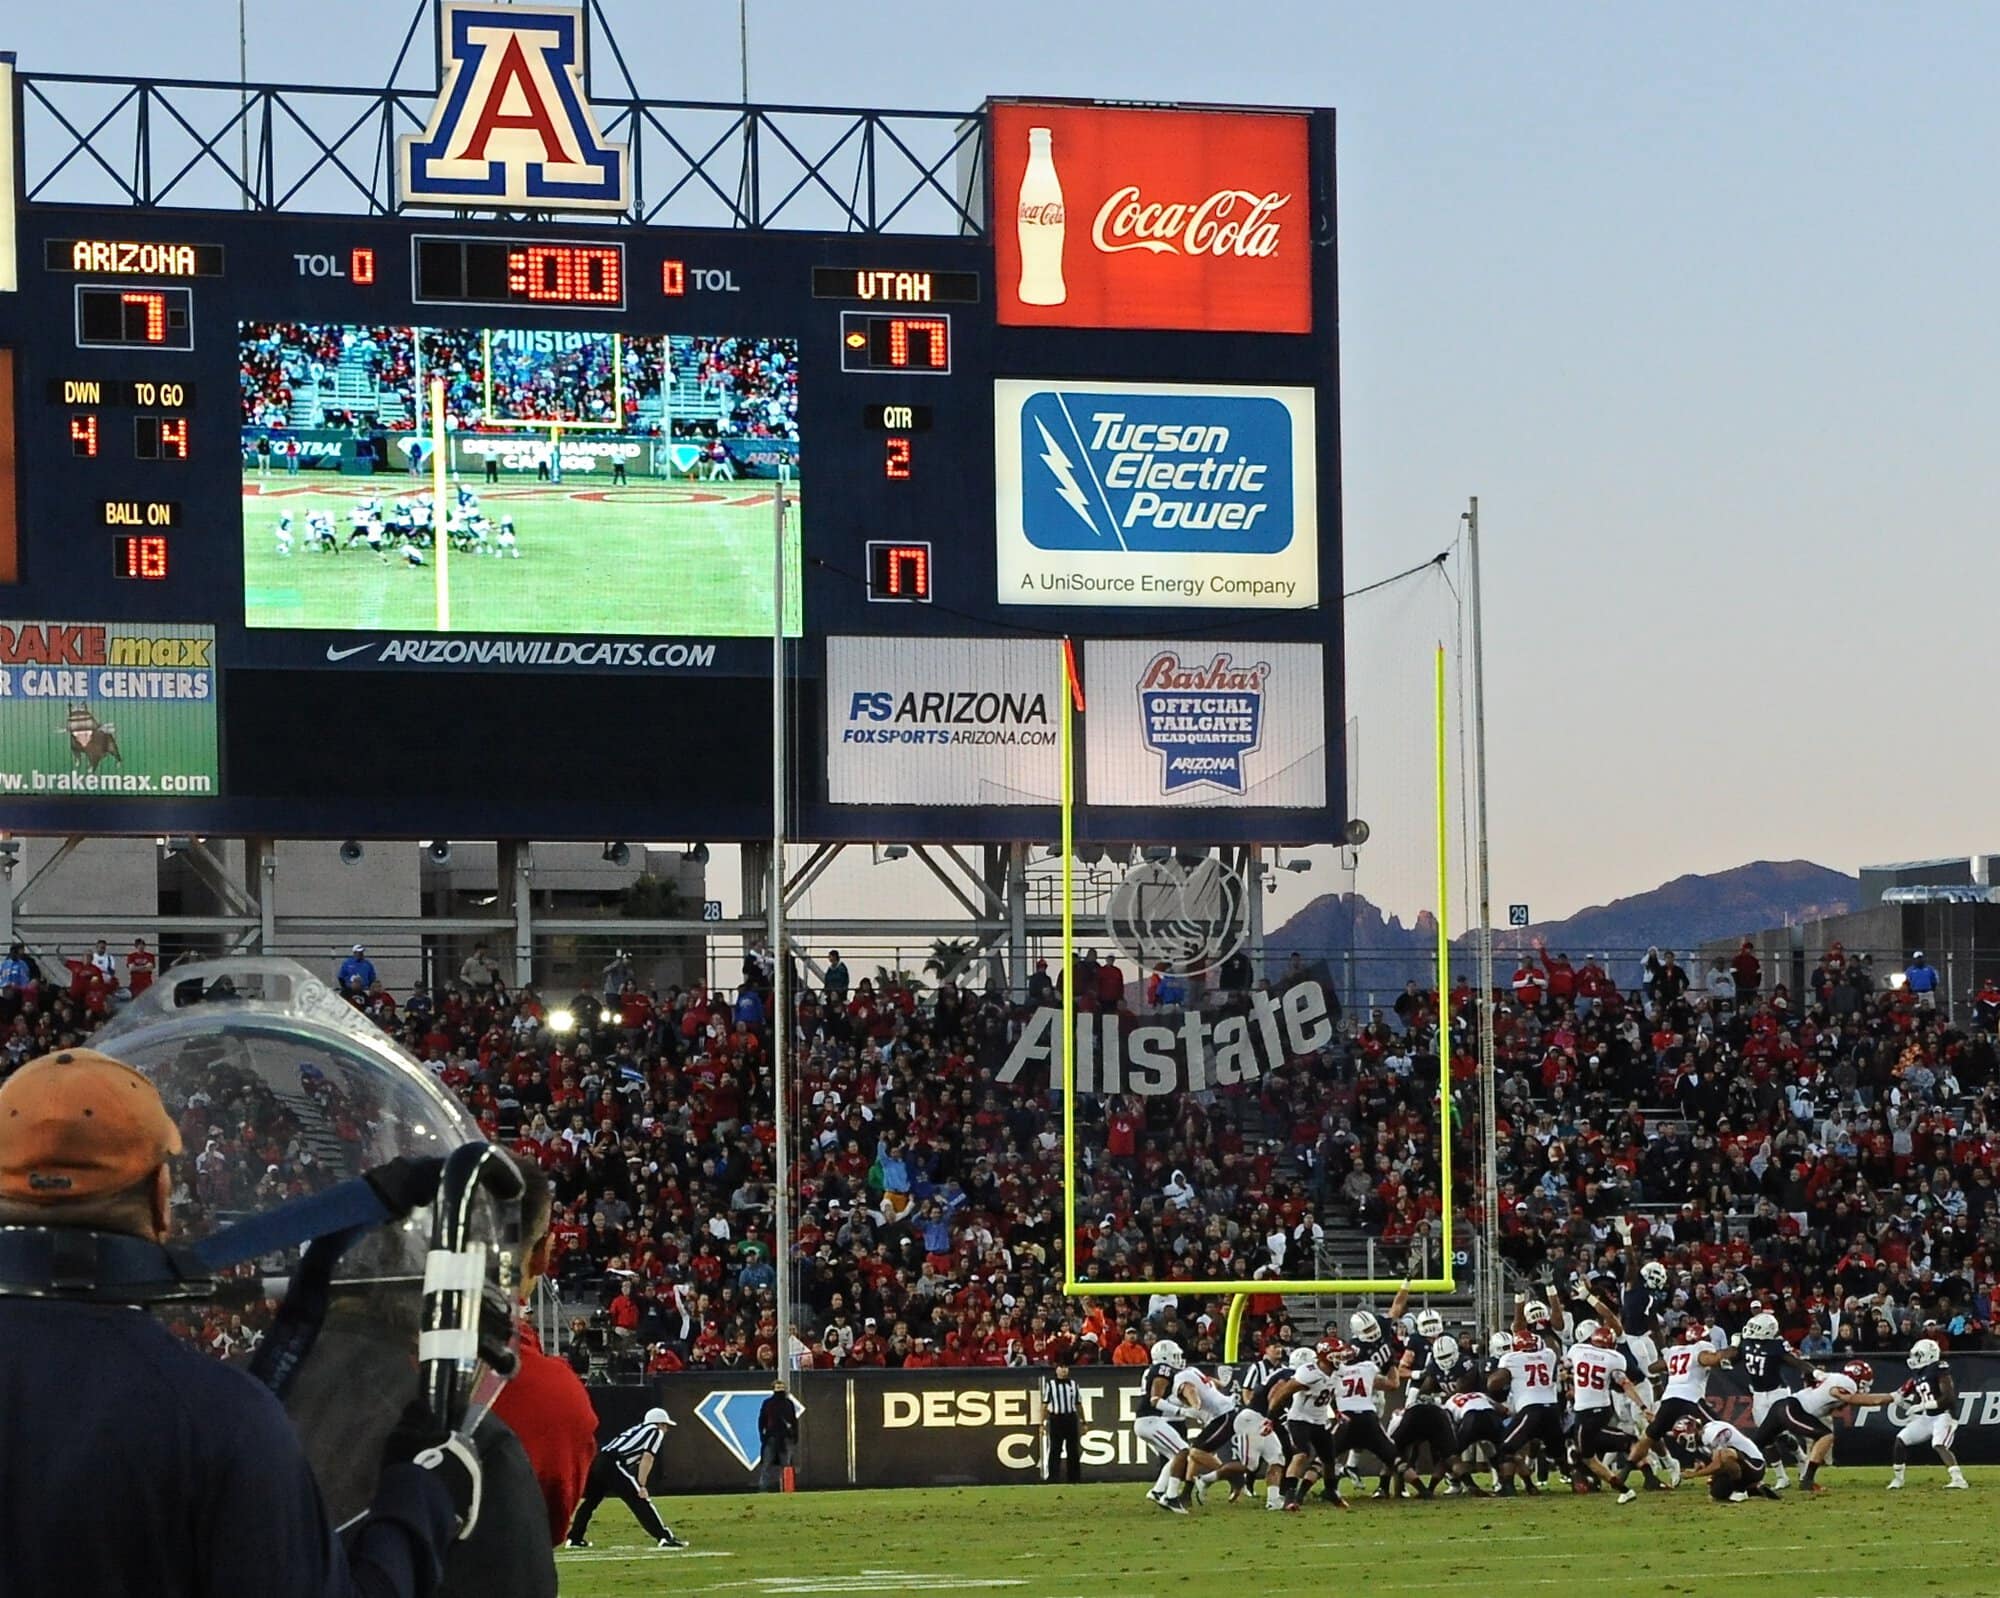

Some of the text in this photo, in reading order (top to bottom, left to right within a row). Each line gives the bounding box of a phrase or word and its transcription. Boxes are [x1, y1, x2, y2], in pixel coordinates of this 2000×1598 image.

[410, 10, 620, 201] A
[1092, 186, 1291, 258] Coca-Cola
[73, 241, 196, 275] ARIZONA
[294, 254, 345, 277] TOL
[352, 248, 374, 284] 0
[663, 260, 684, 296] 0
[692, 269, 740, 293] TOL
[857, 271, 931, 302] UTAH
[122, 292, 164, 341] 7
[890, 320, 945, 366] 17
[65, 381, 100, 404] DWN
[135, 383, 183, 406] TO GO
[884, 406, 912, 429] QTR
[71, 414, 97, 457] 4
[162, 418, 187, 458] 4
[1090, 412, 1230, 453] Tucson
[886, 438, 910, 479] 2
[1105, 456, 1268, 492] Electric
[106, 503, 170, 526] BALL ON
[1122, 492, 1268, 530] Power
[128, 537, 165, 578] 18
[889, 548, 926, 594] 17
[1021, 574, 1296, 598] A UniSource Energy Company
[378, 639, 716, 667] ARIZONAWILDCATS.COM
[22, 669, 89, 698] CARE
[98, 671, 209, 699] CENTERS
[894, 692, 1048, 725] ARIZONA
[1151, 698, 1253, 714] OFFICIAL
[1151, 717, 1253, 731] TAILGATE
[1152, 733, 1252, 743] HEADQUARTERS
[1169, 757, 1236, 770] ARIZONA
[703, 902, 721, 920] 28
[1511, 906, 1528, 924] 29
[994, 980, 1334, 1097] Allstate
[1524, 1364, 1550, 1387] 76
[1576, 1362, 1606, 1390] 95
[1669, 1353, 1690, 1376] 97
[1745, 1354, 1766, 1376] 27
[1342, 1377, 1367, 1398] 74
